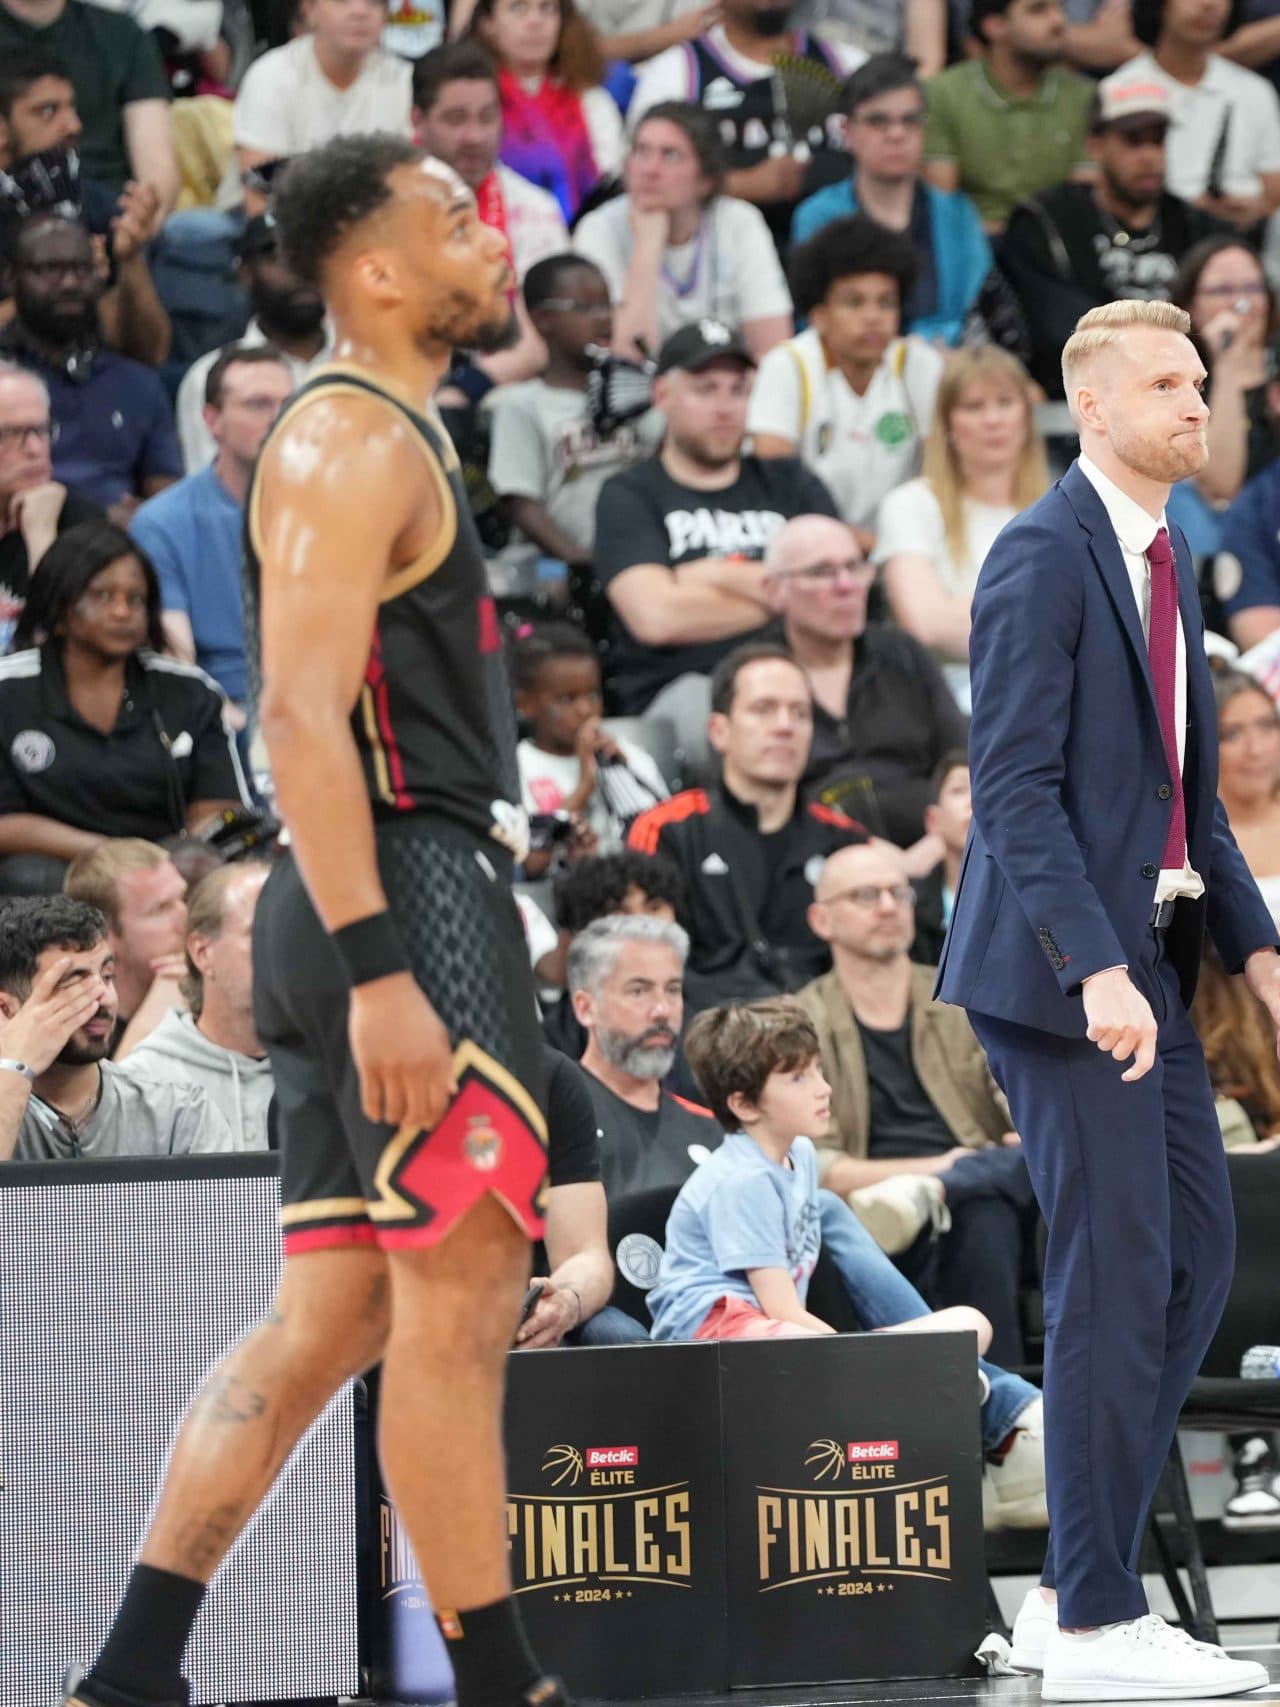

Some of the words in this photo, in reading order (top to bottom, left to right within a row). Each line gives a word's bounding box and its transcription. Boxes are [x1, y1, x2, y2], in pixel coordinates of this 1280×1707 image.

[589, 1448, 635, 1465] Betclic
[851, 1443, 895, 1460] Betclic
[590, 1469, 635, 1487] ÉLITE
[852, 1462, 896, 1481] ÉLITE
[758, 1485, 951, 1580] FINALES
[575, 1588, 612, 1603] 2024
[837, 1582, 874, 1596] 2024
